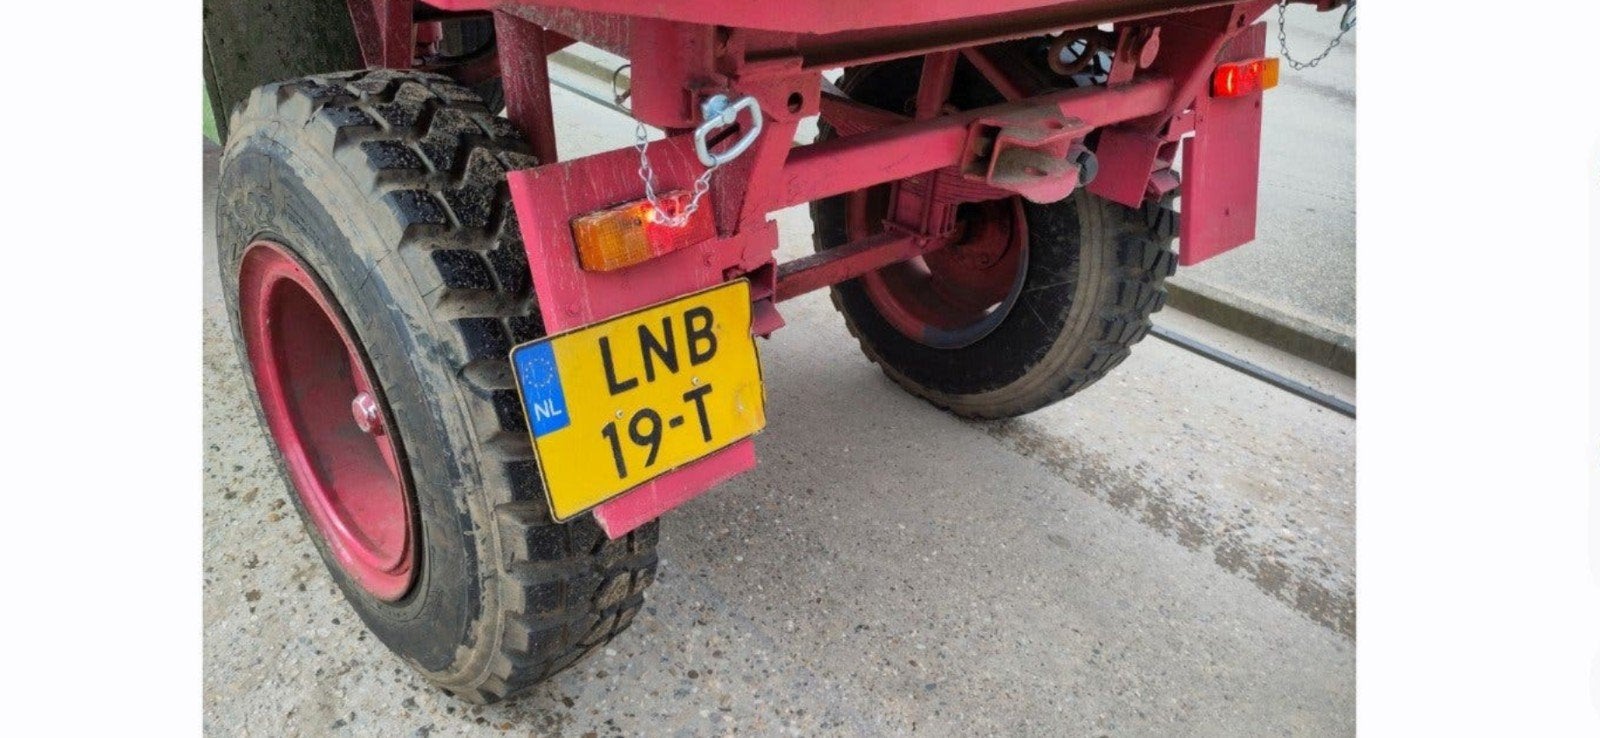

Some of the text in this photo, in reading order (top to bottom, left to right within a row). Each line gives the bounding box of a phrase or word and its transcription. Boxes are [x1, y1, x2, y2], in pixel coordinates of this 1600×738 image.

[598, 306, 718, 396] LNB
[533, 398, 562, 422] NL
[601, 385, 713, 479] 19-T
